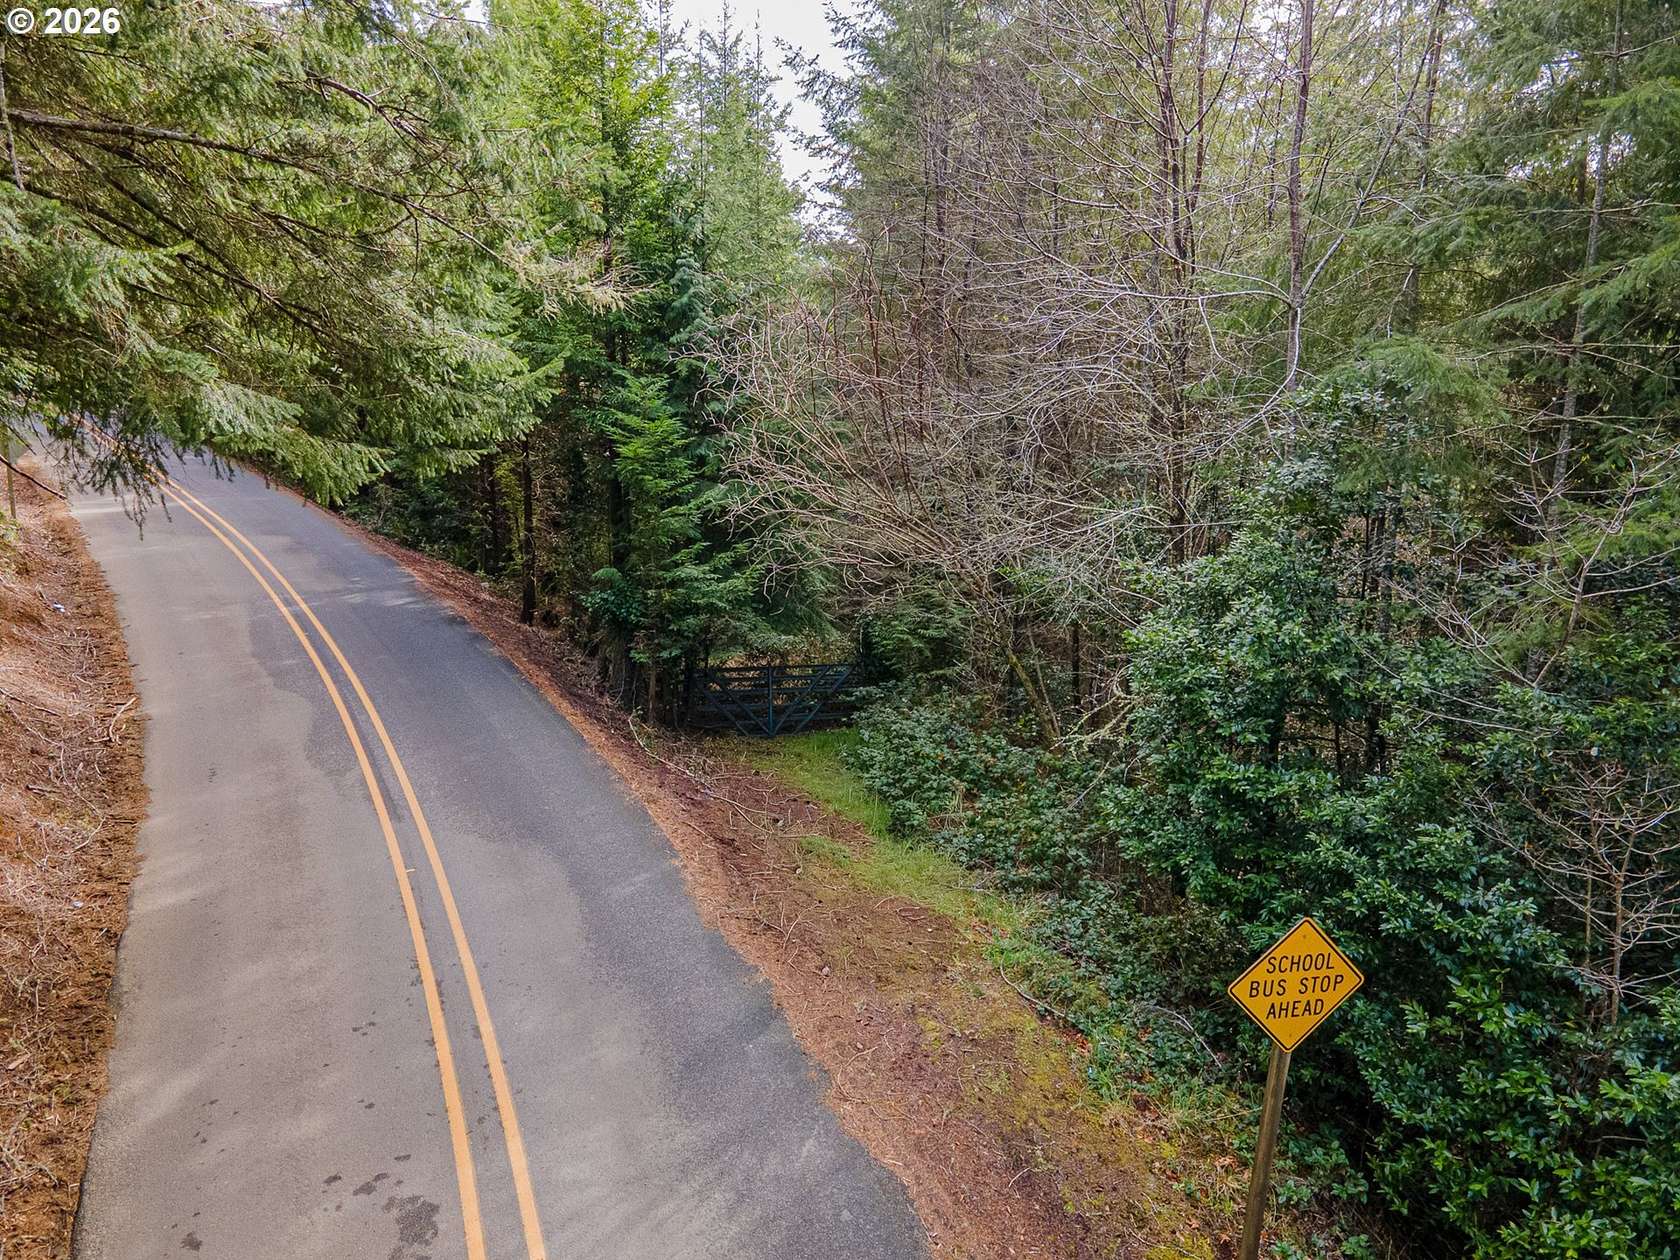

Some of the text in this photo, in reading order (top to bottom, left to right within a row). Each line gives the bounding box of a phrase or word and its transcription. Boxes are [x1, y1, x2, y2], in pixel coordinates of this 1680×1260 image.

[1266, 953, 1335, 974] SCHOOL
[1249, 974, 1344, 998] BUS STOP
[1266, 999, 1324, 1020] AHEAD
